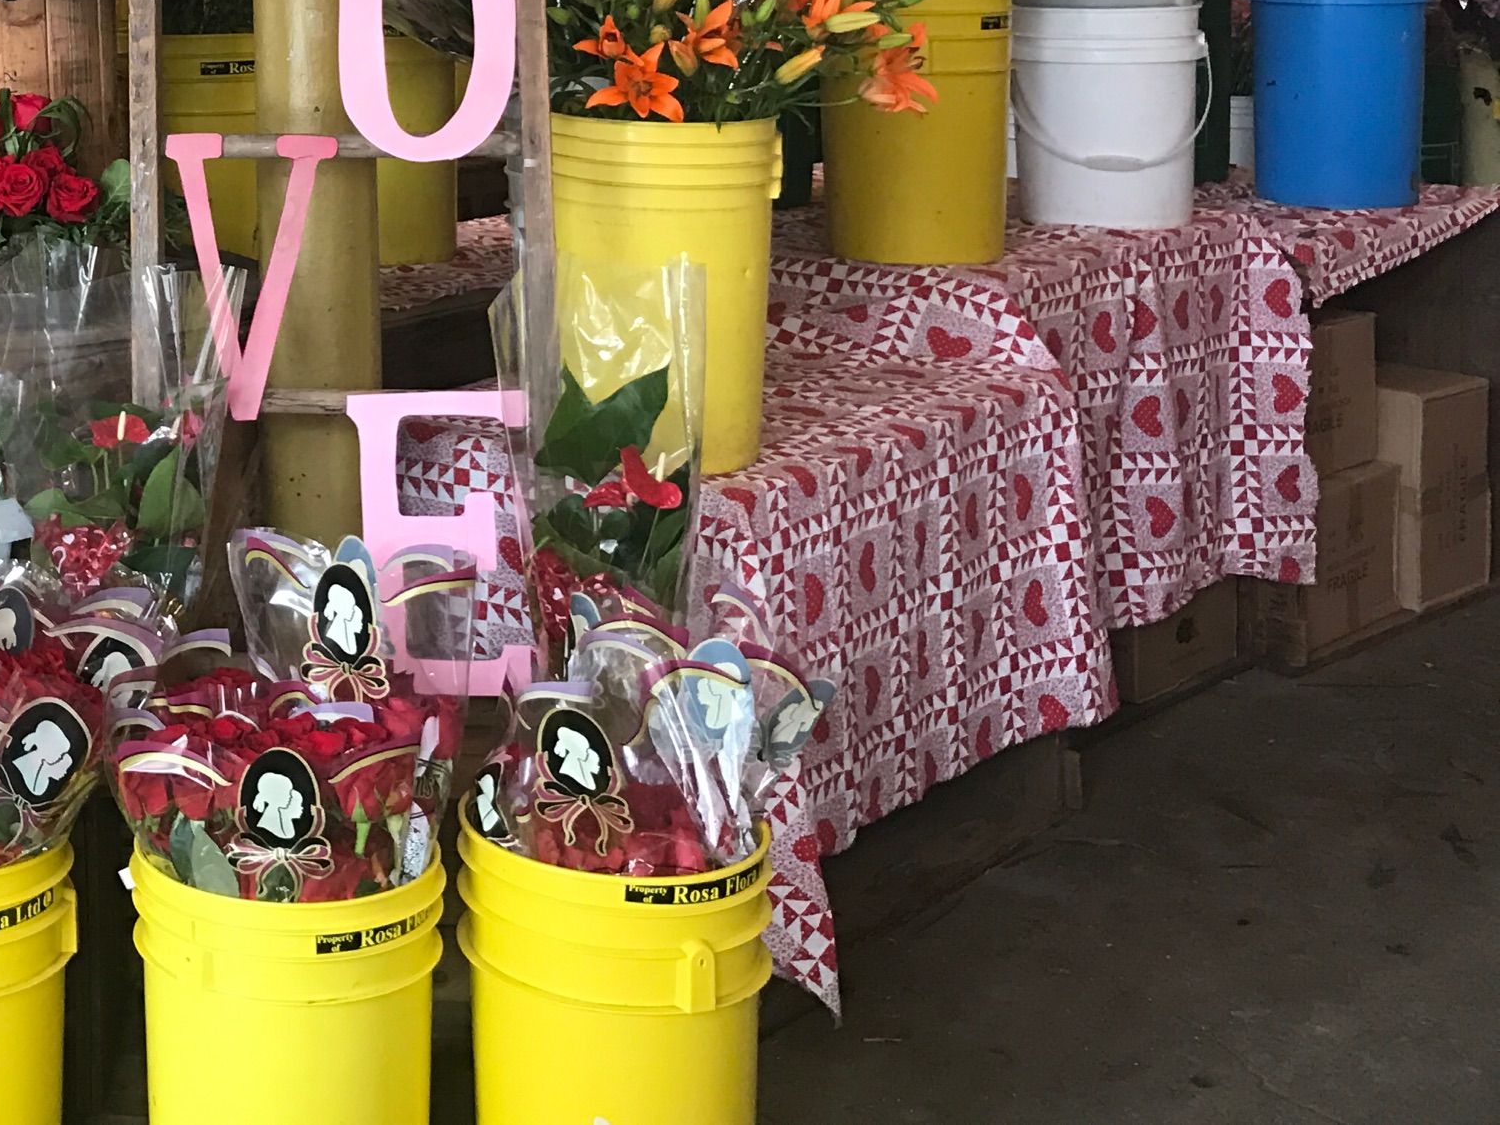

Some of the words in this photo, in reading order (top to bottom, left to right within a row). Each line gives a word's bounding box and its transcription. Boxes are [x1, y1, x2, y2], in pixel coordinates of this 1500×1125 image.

[229, 62, 255, 74] Ros
[1327, 560, 1370, 595] FRAGILE
[628, 884, 668, 896] Property
[672, 885, 720, 904] Rosa
[724, 869, 757, 897] Flora
[642, 895, 654, 904] of
[15, 897, 42, 925] Ltd
[317, 933, 354, 946] Property
[360, 924, 402, 948] Rosa
[331, 943, 341, 953] of
